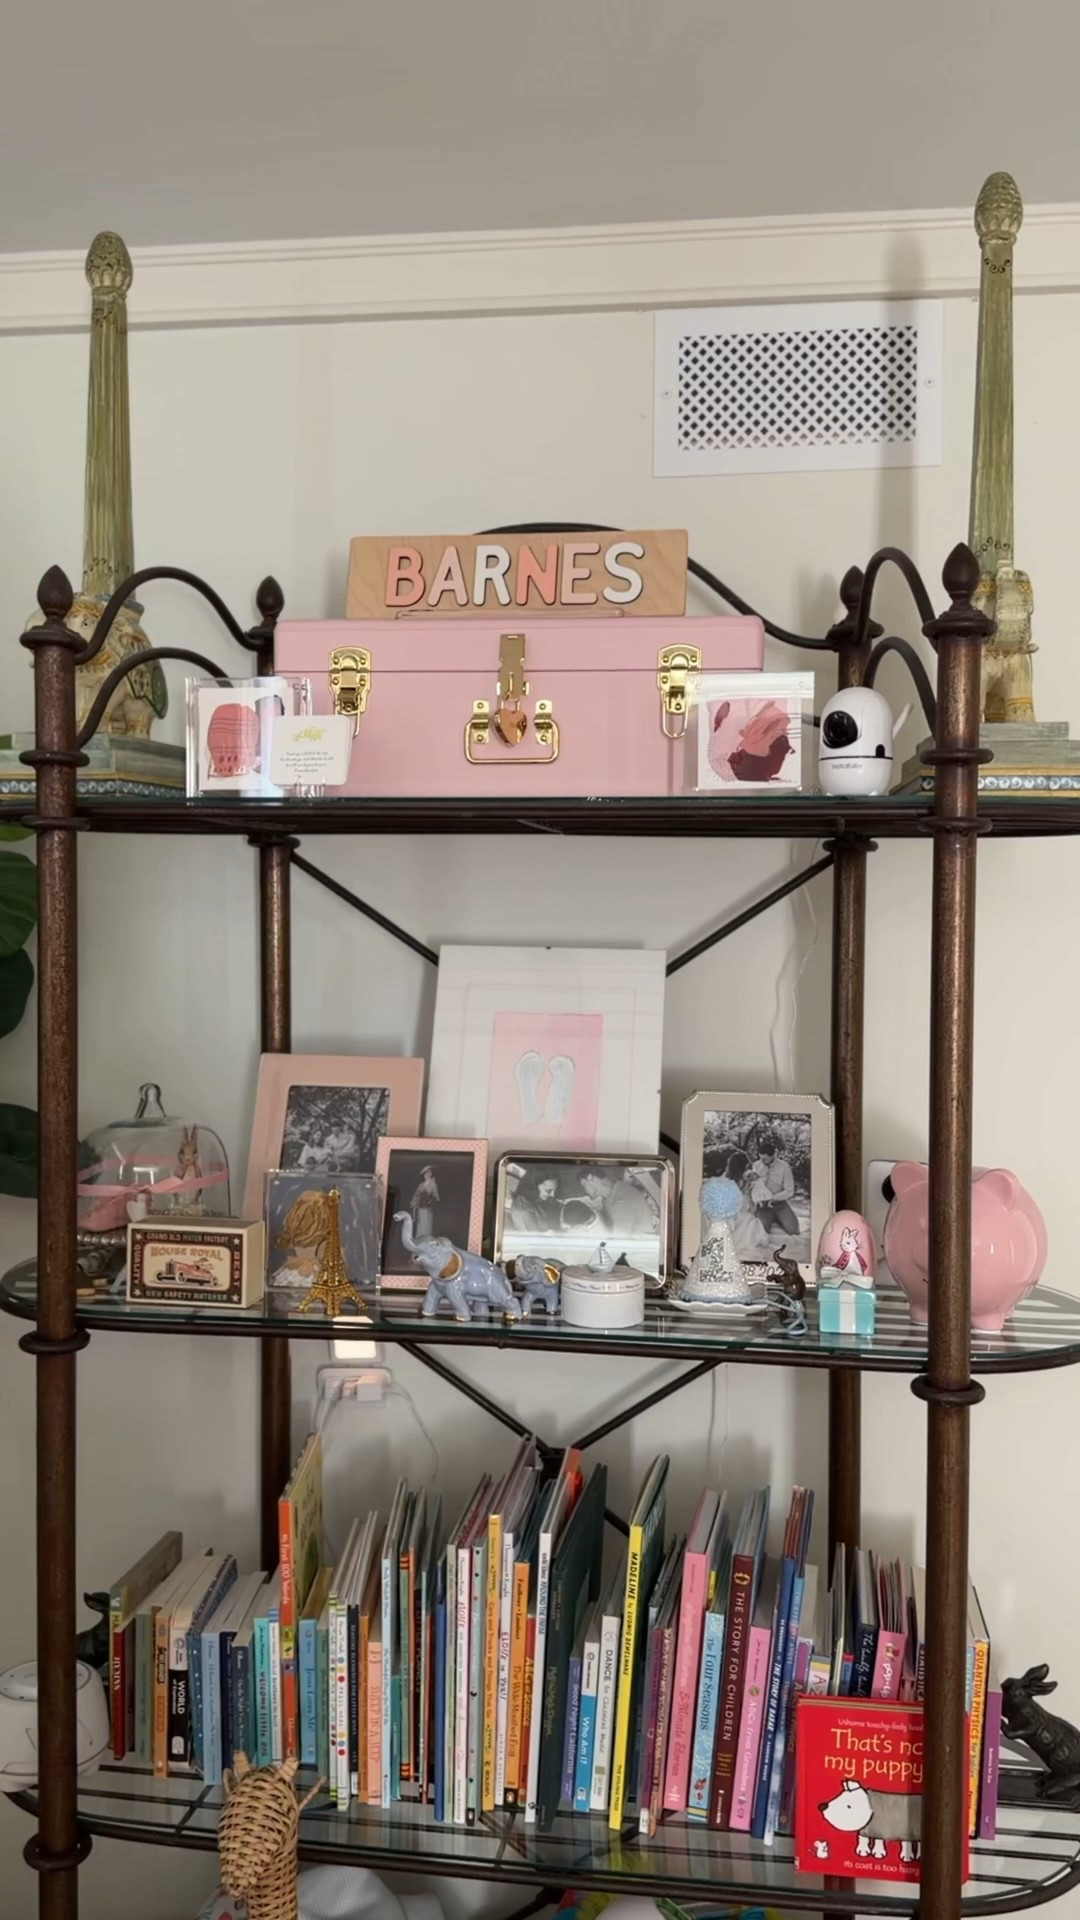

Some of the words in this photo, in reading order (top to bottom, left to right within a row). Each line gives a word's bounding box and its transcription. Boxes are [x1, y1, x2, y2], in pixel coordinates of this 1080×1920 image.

[385, 541, 645, 607] BARNES
[190, 1248, 224, 1261] ROYAL
[233, 1251, 241, 1287] BEST
[164, 1291, 192, 1299] SAFETY
[281, 1543, 291, 1561] First
[281, 1563, 291, 1578] 100
[628, 1552, 639, 1599] MADELINE
[282, 1579, 291, 1605] Words
[734, 1592, 745, 1614] THE
[488, 1602, 496, 1617] Cars
[514, 1613, 522, 1640] Lambert
[731, 1617, 743, 1654] STORY
[603, 1649, 613, 1682] DANCE
[623, 1637, 632, 1676] BEMELMANS
[705, 1654, 717, 1682] Four
[773, 1662, 781, 1675] THE
[304, 1668, 315, 1690] Jesus
[485, 1670, 494, 1692] Things
[514, 1665, 522, 1681] The
[729, 1657, 739, 1681] FOR
[973, 1649, 985, 1698] QUANTUM
[177, 1680, 186, 1714] WORLD
[770, 1676, 780, 1697] STORY
[486, 1710, 492, 1719] Go
[700, 1683, 715, 1731] Seasons
[722, 1684, 736, 1741] CHILDREN
[770, 1699, 777, 1708] OF
[260, 1712, 268, 1737] little
[568, 1707, 579, 1732] Night
[581, 1716, 591, 1737] Who
[767, 1708, 777, 1732] BABAR
[838, 1718, 865, 1728] Usborne
[970, 1700, 980, 1740] PHYSICS
[370, 1730, 380, 1738] A
[745, 1727, 755, 1750] from
[831, 1728, 892, 1754] That's
[508, 1738, 518, 1758] Frog
[566, 1732, 577, 1775] California
[580, 1739, 589, 1754] Am
[579, 1756, 588, 1765] I?
[671, 1741, 684, 1777] Stories
[824, 1755, 856, 1778] my
[863, 1758, 924, 1783] puppy
[739, 1751, 752, 1792] Grandma
[855, 1862, 873, 1871] coat
[882, 1864, 898, 1872] too
[898, 1864, 920, 1877] hairy
